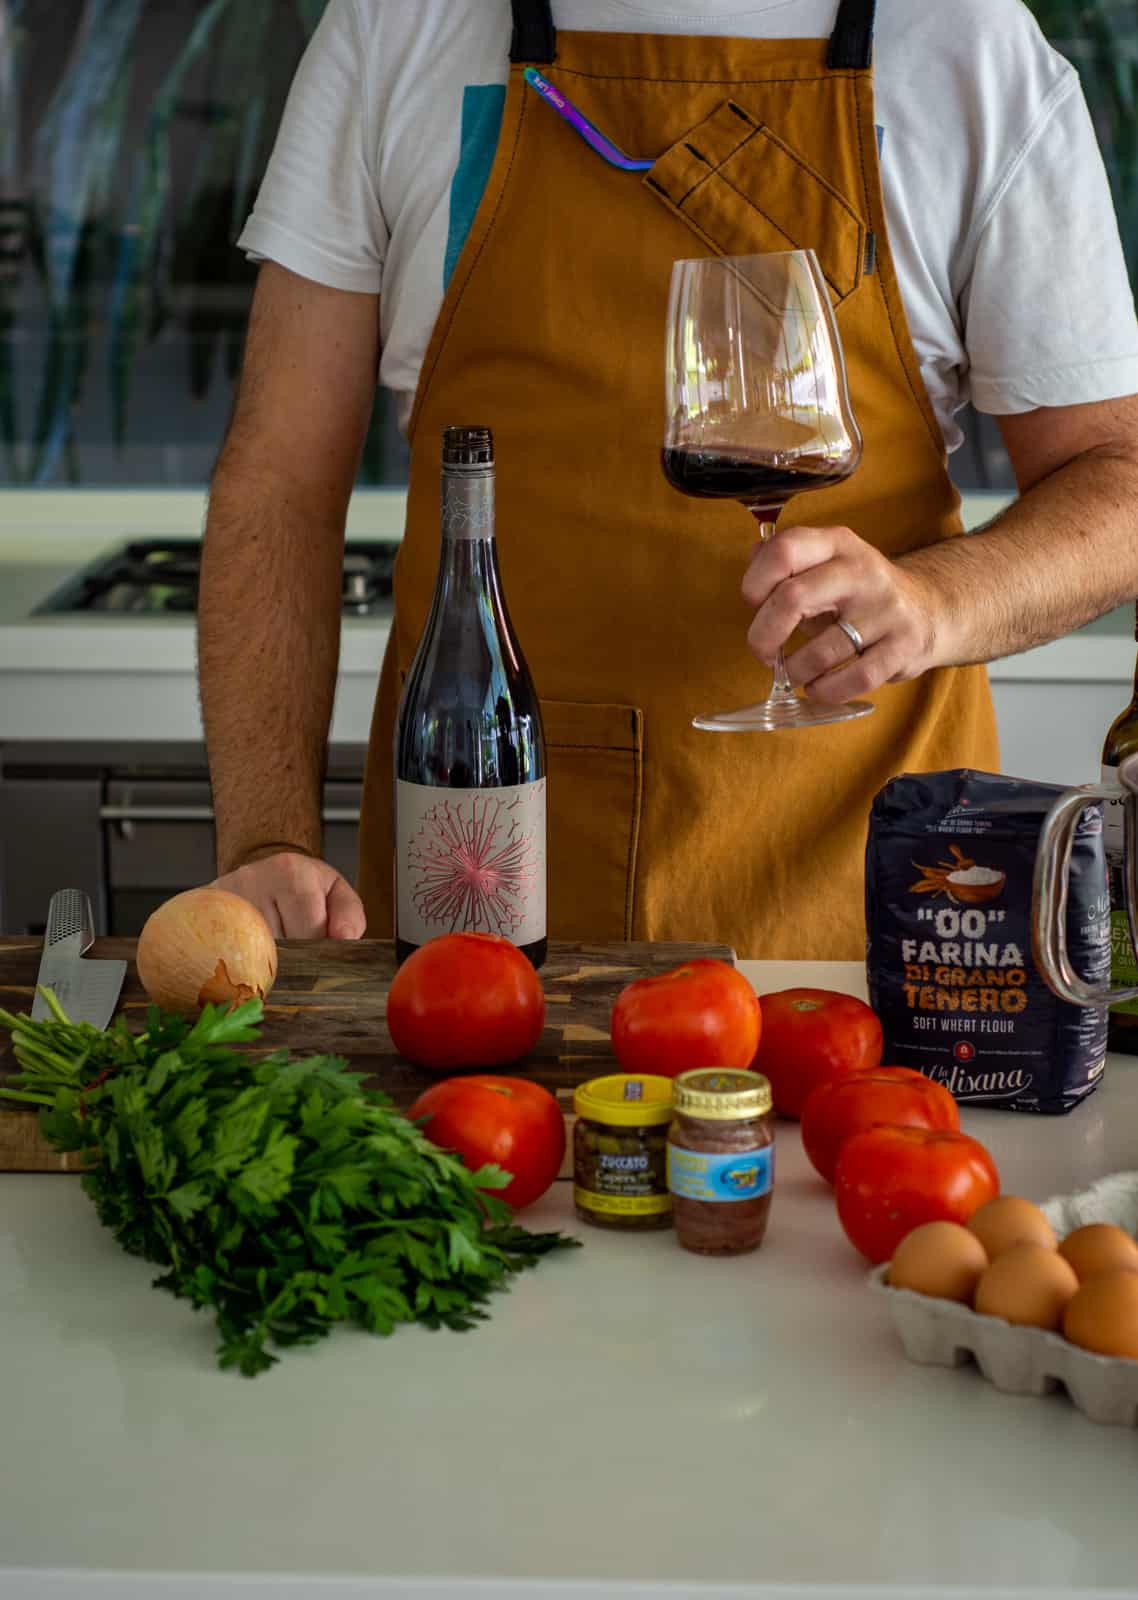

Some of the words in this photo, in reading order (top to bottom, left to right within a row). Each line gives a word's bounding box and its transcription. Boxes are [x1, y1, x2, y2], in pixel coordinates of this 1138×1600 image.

[901, 939, 1024, 967] FARINA
[903, 964, 930, 981] DI
[935, 966, 1027, 987] GRANO
[902, 982, 1028, 1012] TENERO
[912, 1015, 937, 1030] SOFT
[940, 1018, 977, 1032] WHEAT
[980, 1019, 1015, 1033] FLOUR
[600, 1155, 649, 1169] ZUCCATO
